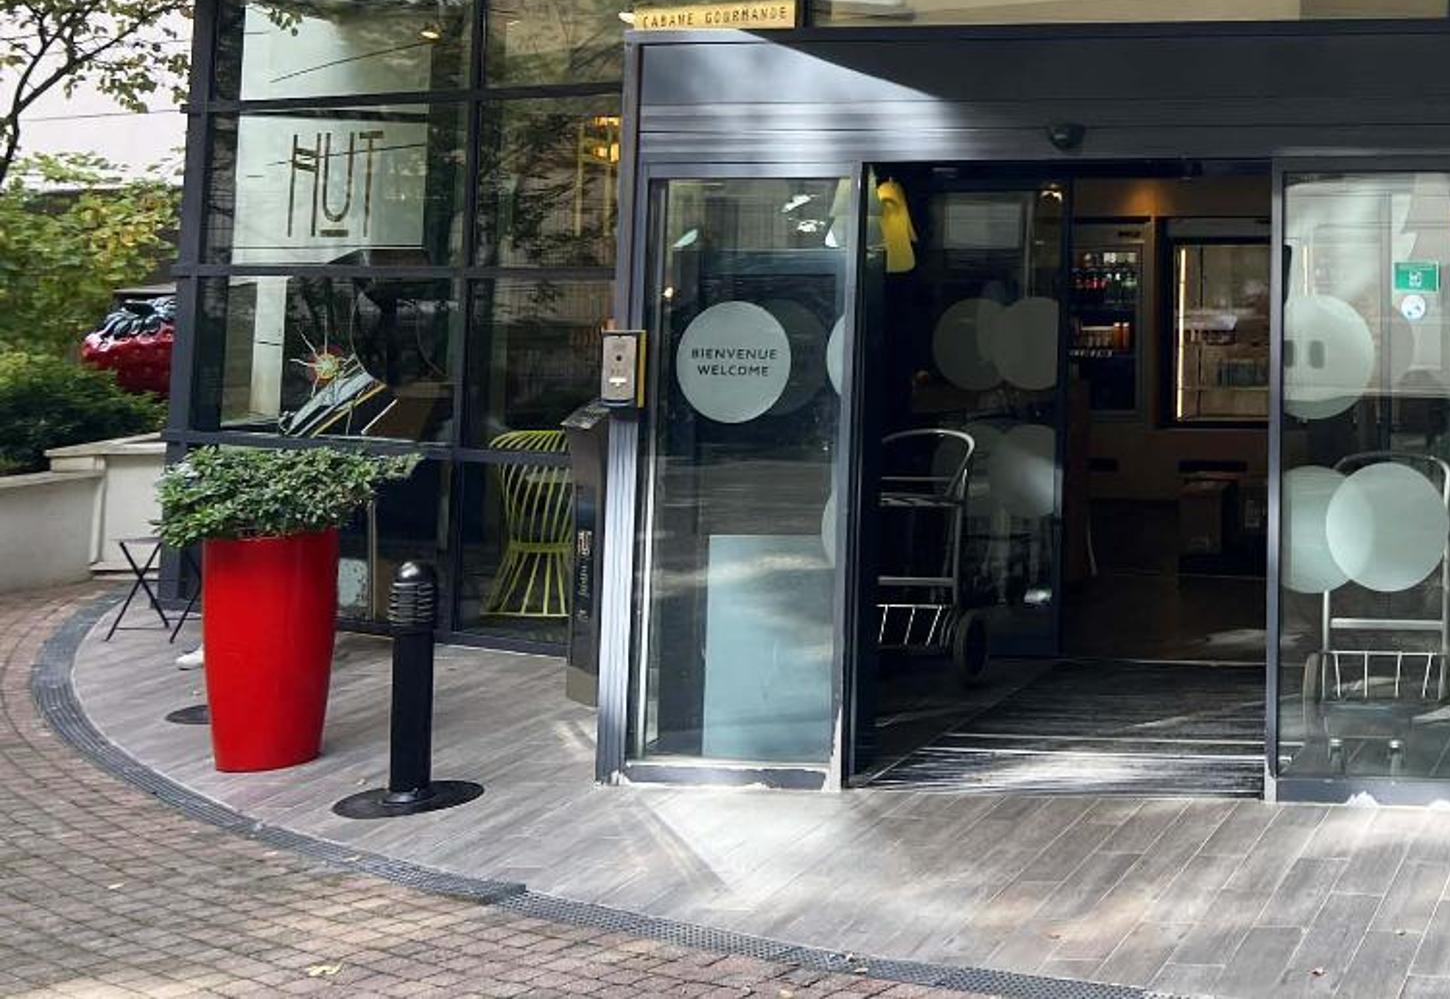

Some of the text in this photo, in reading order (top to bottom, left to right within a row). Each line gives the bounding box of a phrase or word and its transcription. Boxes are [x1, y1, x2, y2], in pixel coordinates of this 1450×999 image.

[643, 6, 787, 29] CABANE GOURMANDE
[287, 130, 384, 238] HUT
[691, 347, 777, 360] BIENVENUE
[697, 364, 769, 377] WELCOME
